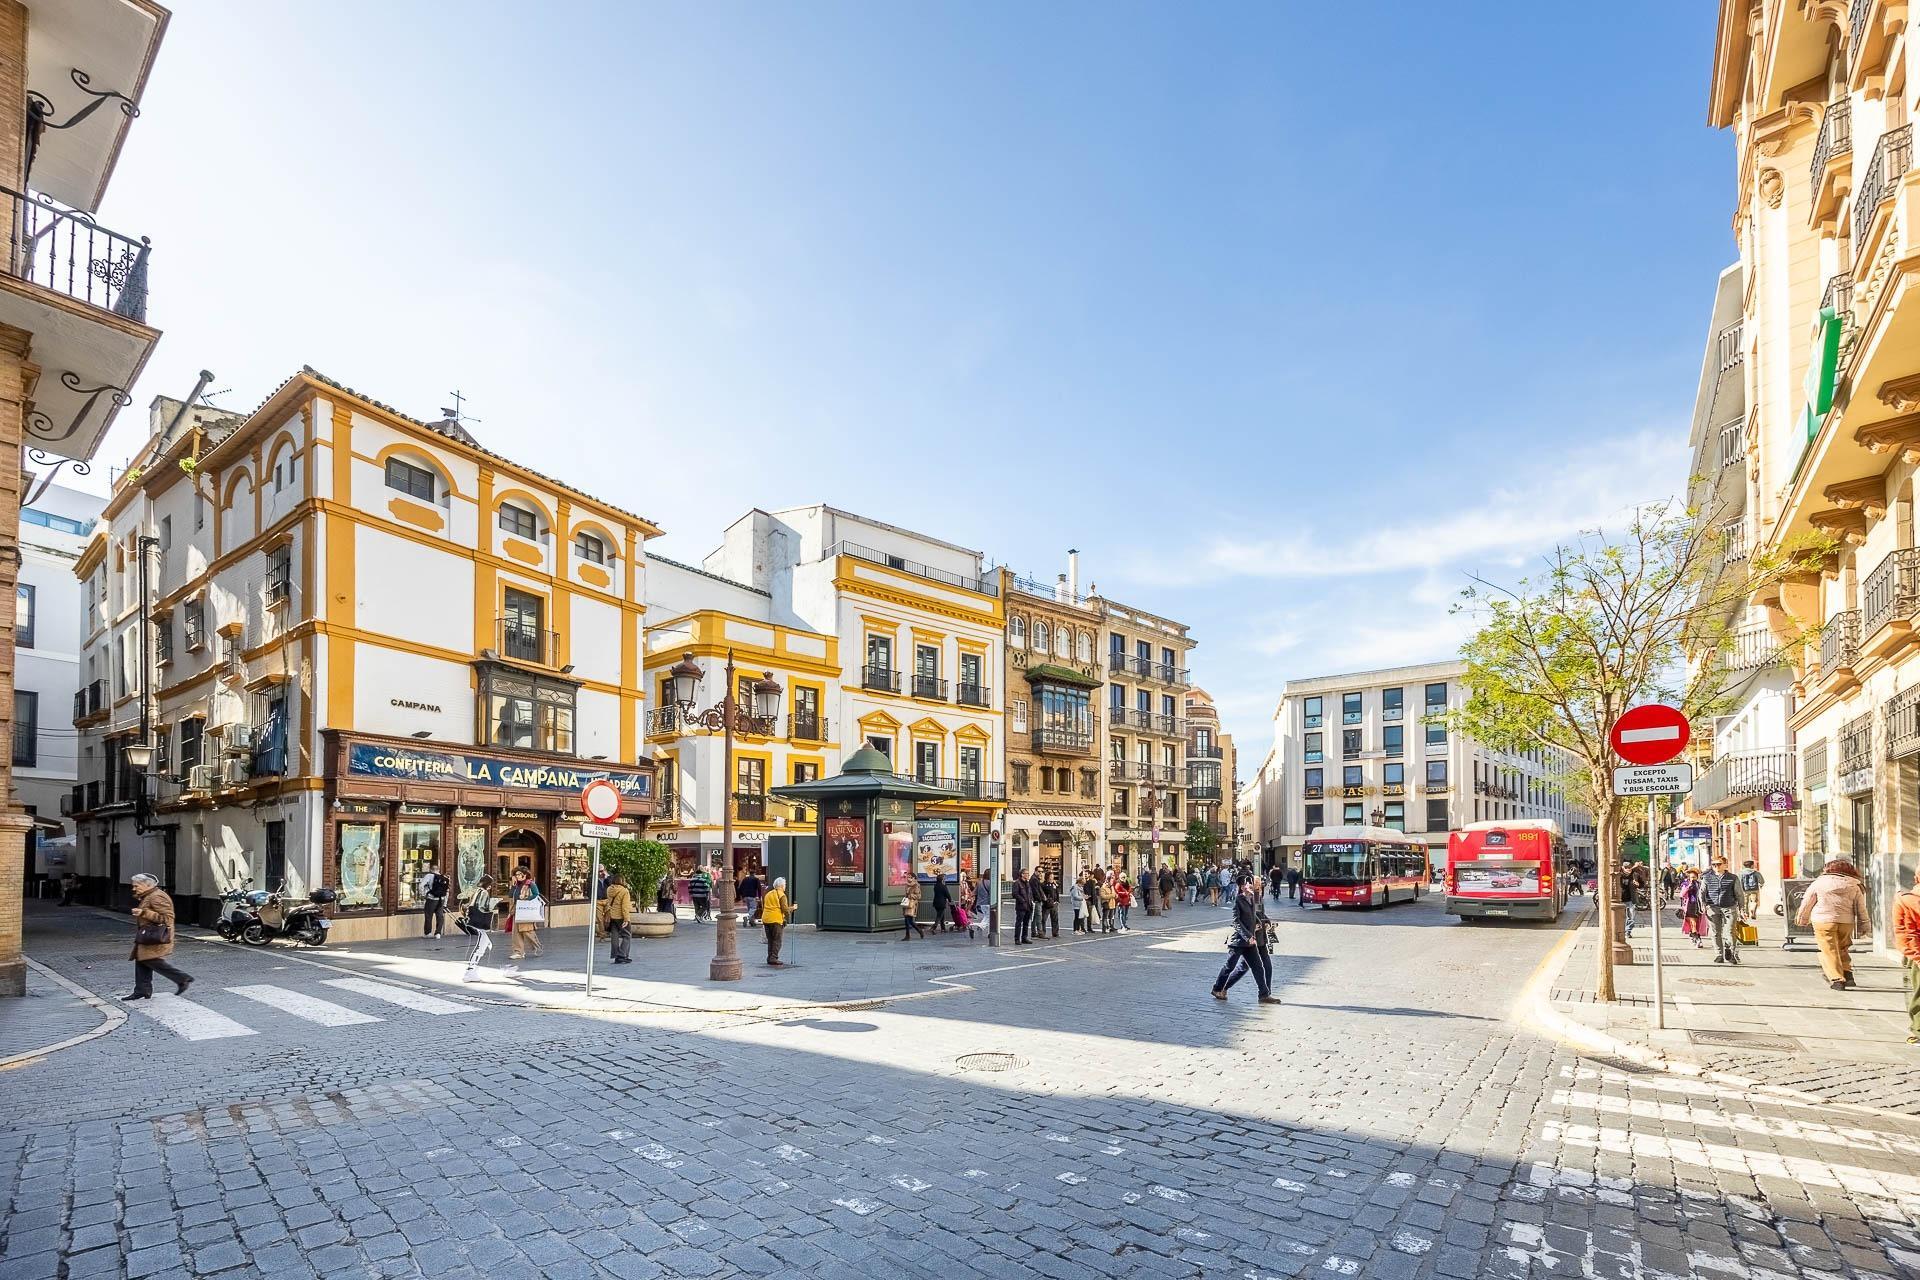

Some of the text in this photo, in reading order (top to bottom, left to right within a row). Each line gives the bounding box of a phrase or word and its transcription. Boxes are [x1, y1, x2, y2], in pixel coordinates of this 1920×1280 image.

[390, 699, 441, 713] CAMPANA
[374, 756, 453, 774] CONFITERIA
[466, 762, 491, 780] LA
[499, 766, 579, 788] CAMPANA
[355, 805, 368, 813] THE
[1518, 832, 1538, 841] 1891
[1312, 844, 1322, 853] 27
